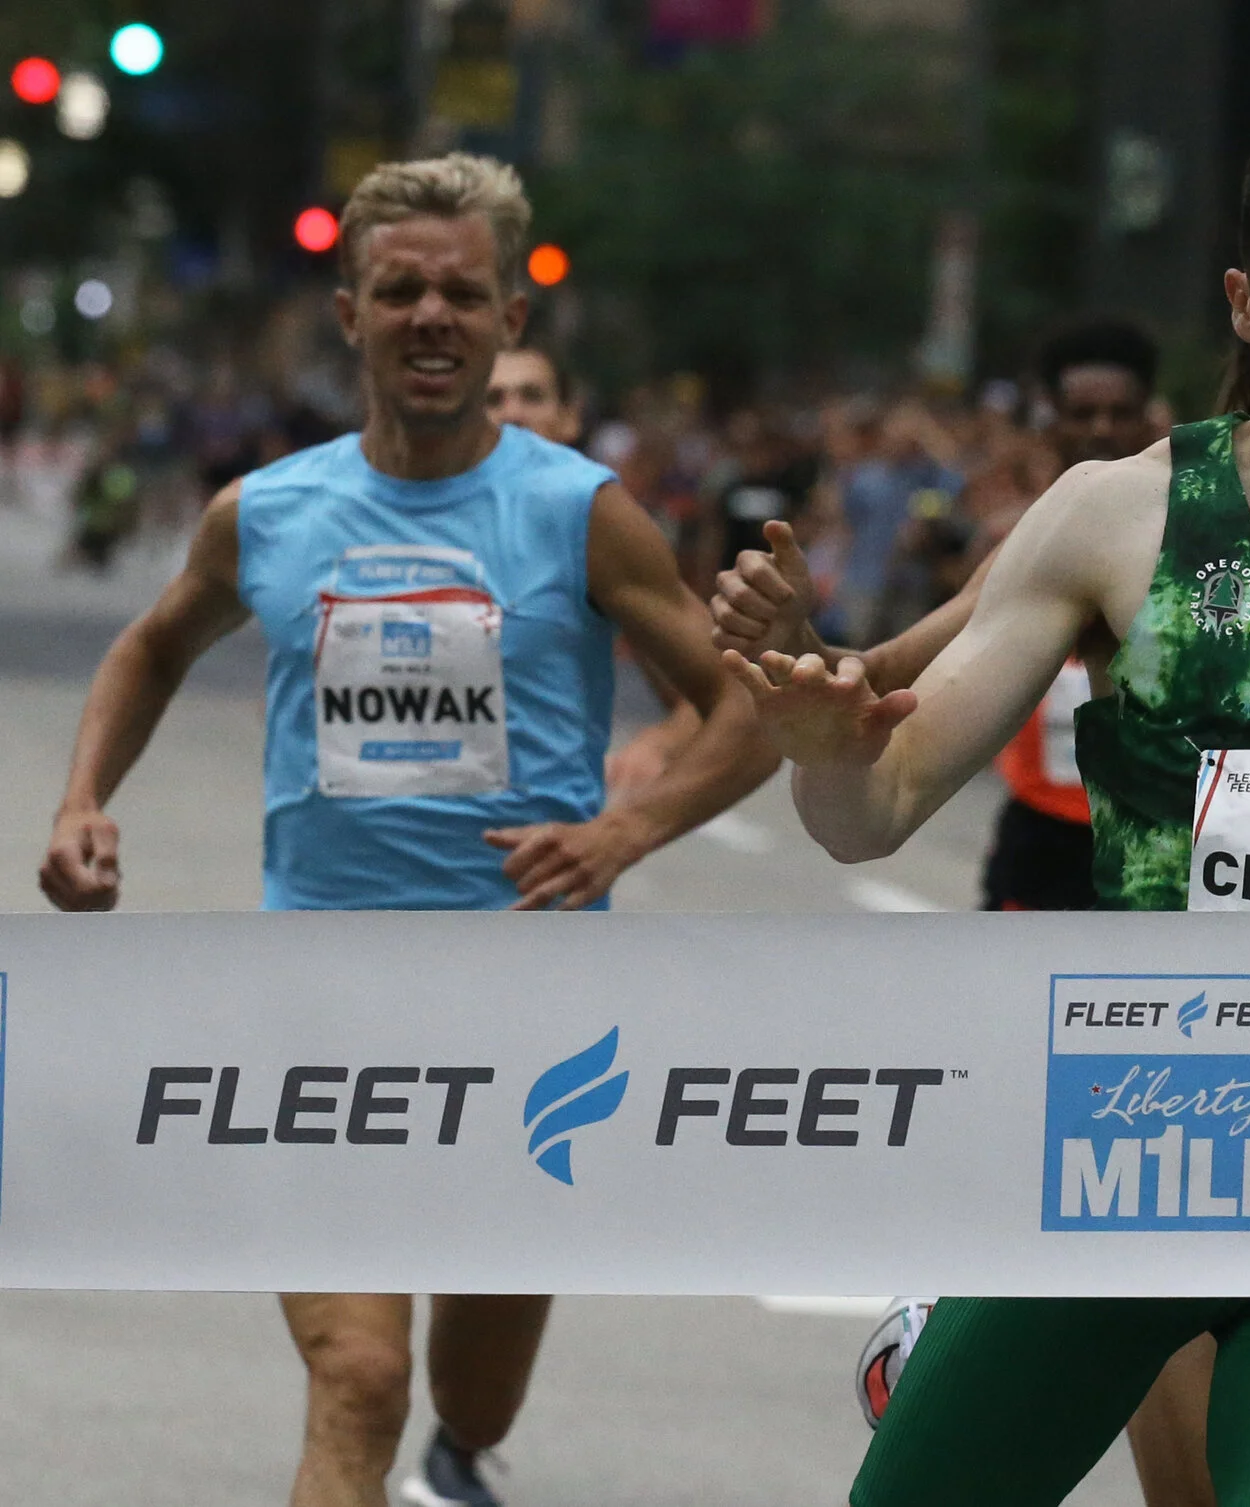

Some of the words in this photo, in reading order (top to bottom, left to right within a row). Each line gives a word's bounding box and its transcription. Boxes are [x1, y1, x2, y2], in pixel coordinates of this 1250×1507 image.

[1190, 592, 1210, 632] TRACK
[323, 687, 497, 724] NOWAK
[1064, 1002, 1169, 1027] FLEET
[136, 1066, 495, 1145] FLEET
[655, 1068, 944, 1146] FEET
